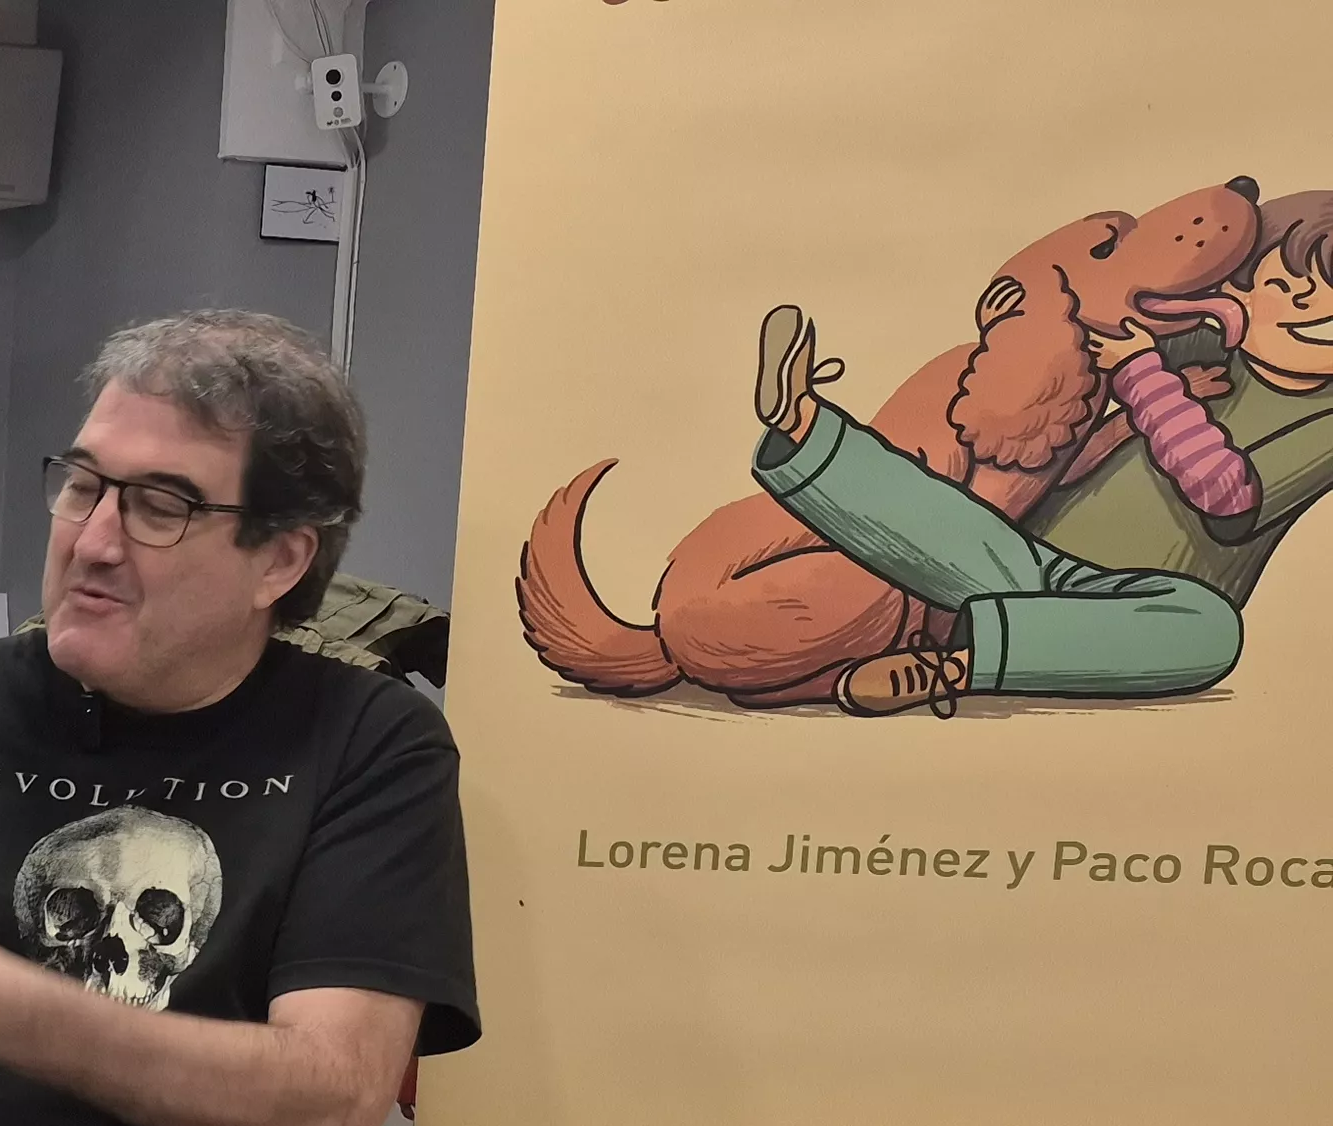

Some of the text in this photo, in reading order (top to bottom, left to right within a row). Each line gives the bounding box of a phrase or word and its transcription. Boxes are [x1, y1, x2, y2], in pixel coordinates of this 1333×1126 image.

[576, 829, 1333, 890] Lorena Jiménez y Paco Roca
